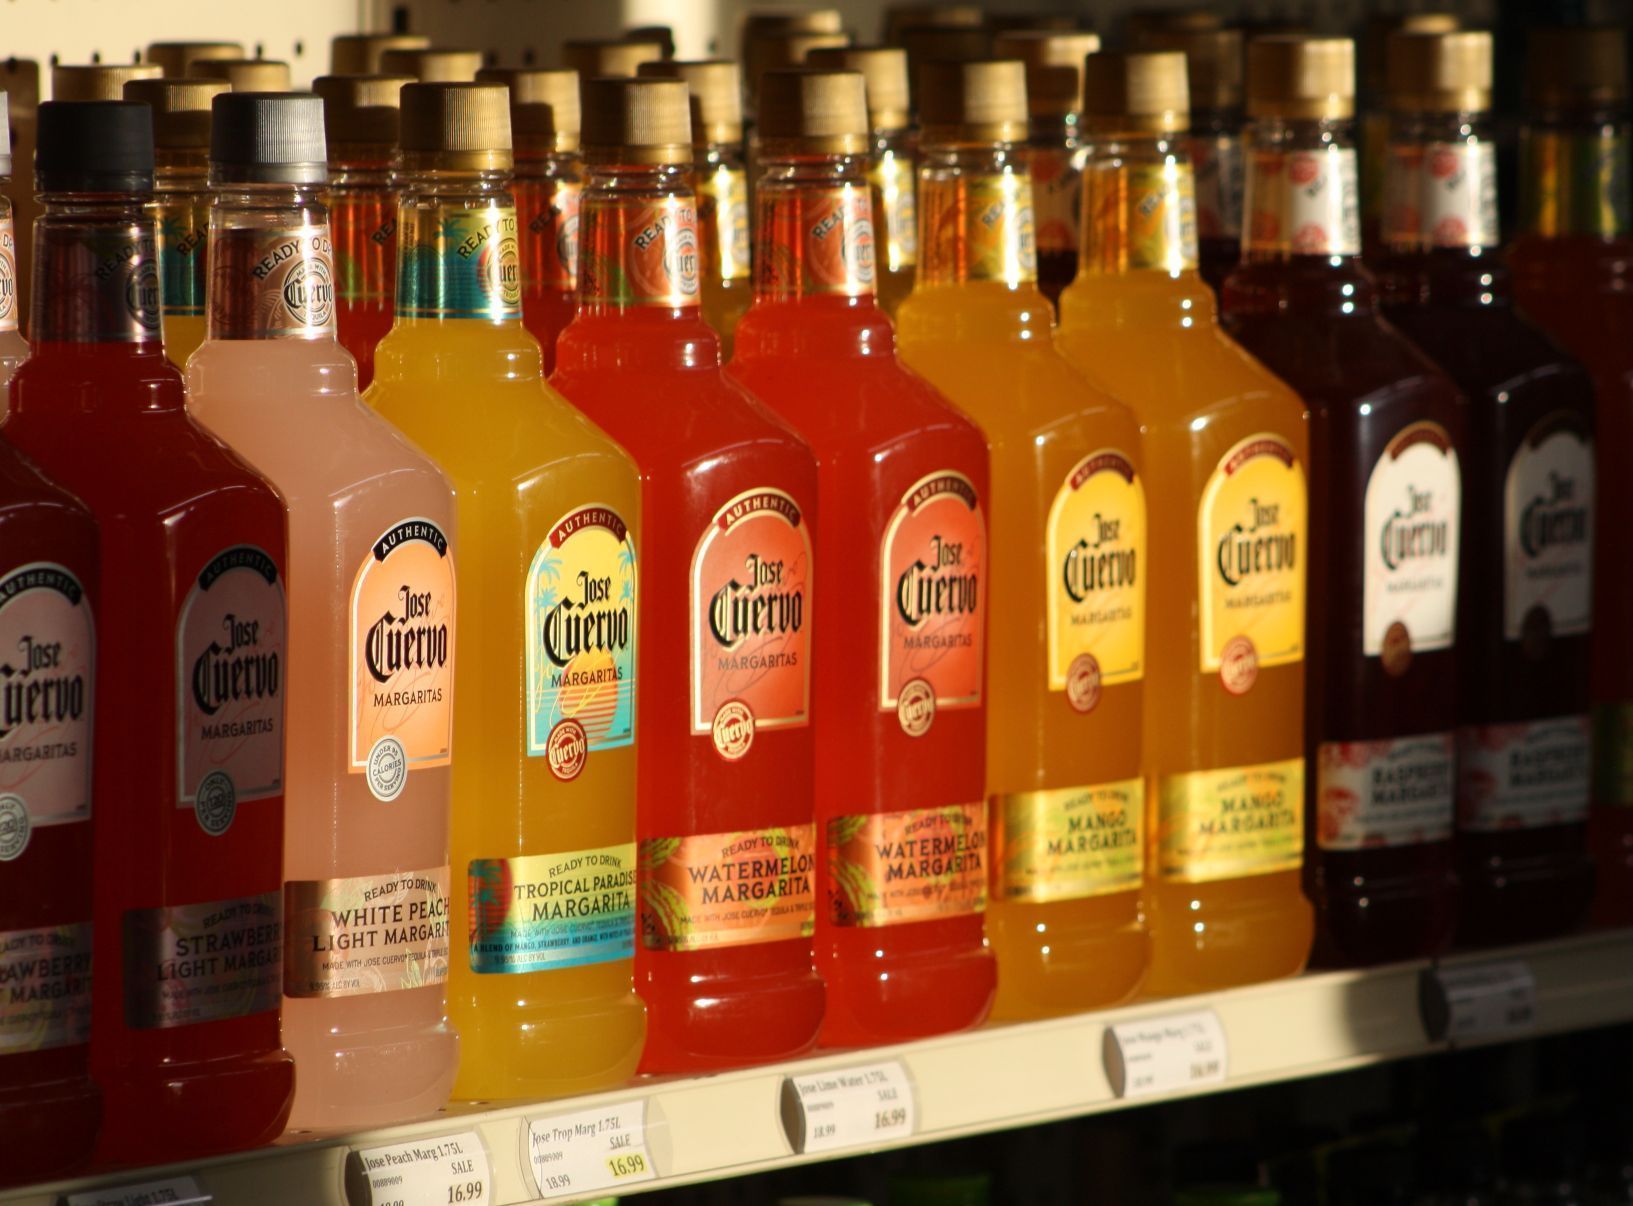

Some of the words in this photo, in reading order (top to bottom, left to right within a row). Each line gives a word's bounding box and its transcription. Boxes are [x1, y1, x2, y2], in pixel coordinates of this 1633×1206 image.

[726, 496, 796, 525] AUTHENTIC
[558, 510, 623, 542] AUTHENTIC
[1093, 512, 1120, 549] Jose
[381, 525, 445, 554] AUTHENTIC
[929, 534, 963, 573] Jose
[1217, 524, 1296, 586] Cuervo
[745, 553, 784, 592] Jose
[1063, 539, 1136, 603] Cuervo
[577, 570, 612, 610] Jose
[896, 560, 977, 627] Cuervo
[398, 584, 432, 626] Jose
[708, 579, 803, 648] Cuervo
[223, 613, 259, 655] Jose
[543, 596, 628, 668] Cuervo
[904, 633, 973, 650] MARGARITAS
[18, 635, 62, 676] Jose
[364, 610, 448, 684] Cuervo
[718, 652, 798, 671] MARGARITAS
[192, 641, 278, 714] Cuervo
[551, 666, 623, 688] MARGARITAS
[0, 664, 84, 738] uervo
[373, 687, 443, 707] MARGARITAS
[200, 718, 274, 741] MARGARITAS
[0, 743, 77, 763] ARGARITAS
[549, 737, 586, 769] Cuervo
[372, 758, 402, 777] CALORIES
[1067, 810, 1127, 833] MANGO
[722, 840, 757, 858] READY
[761, 837, 774, 848] TO
[776, 836, 799, 850] DRINK
[1047, 829, 1137, 856] MARGARITA
[548, 856, 583, 878] READY
[586, 855, 598, 866] TO
[599, 854, 622, 868] DRINK
[886, 853, 981, 882] MARGARITA
[365, 882, 400, 902] READY
[401, 879, 413, 891] TO
[415, 878, 437, 893] DRINK
[514, 876, 590, 901] TROPICAL
[702, 877, 810, 905] MARGARITA
[332, 904, 403, 929] WHITE
[532, 891, 630, 921] MARGARITA
[311, 930, 379, 952] LIGHT
[480, 943, 503, 953] BLEND
[504, 942, 513, 952] OF
[157, 958, 219, 981] LIGHT
[322, 958, 344, 970] MADE
[346, 958, 362, 969] WITH
[363, 956, 381, 967] JOSE
[816, 1079, 839, 1092] Lime
[838, 1075, 863, 1088] Water
[877, 1087, 898, 1101] SALE
[874, 1107, 906, 1130] 16.99
[532, 1132, 551, 1148] Jose
[552, 1127, 573, 1142] Trop
[574, 1123, 596, 1137] Marg
[598, 1116, 621, 1132] 1.75L
[609, 1133, 631, 1150] SALE
[365, 1157, 385, 1172] Jose
[386, 1150, 413, 1166] Peach
[414, 1148, 438, 1161] Marg
[438, 1142, 464, 1157] 1.75L
[451, 1159, 474, 1175] SALE
[608, 1154, 645, 1177] 16.99
[448, 1180, 482, 1204] 16.99
[545, 1174, 571, 1190] 18.99
